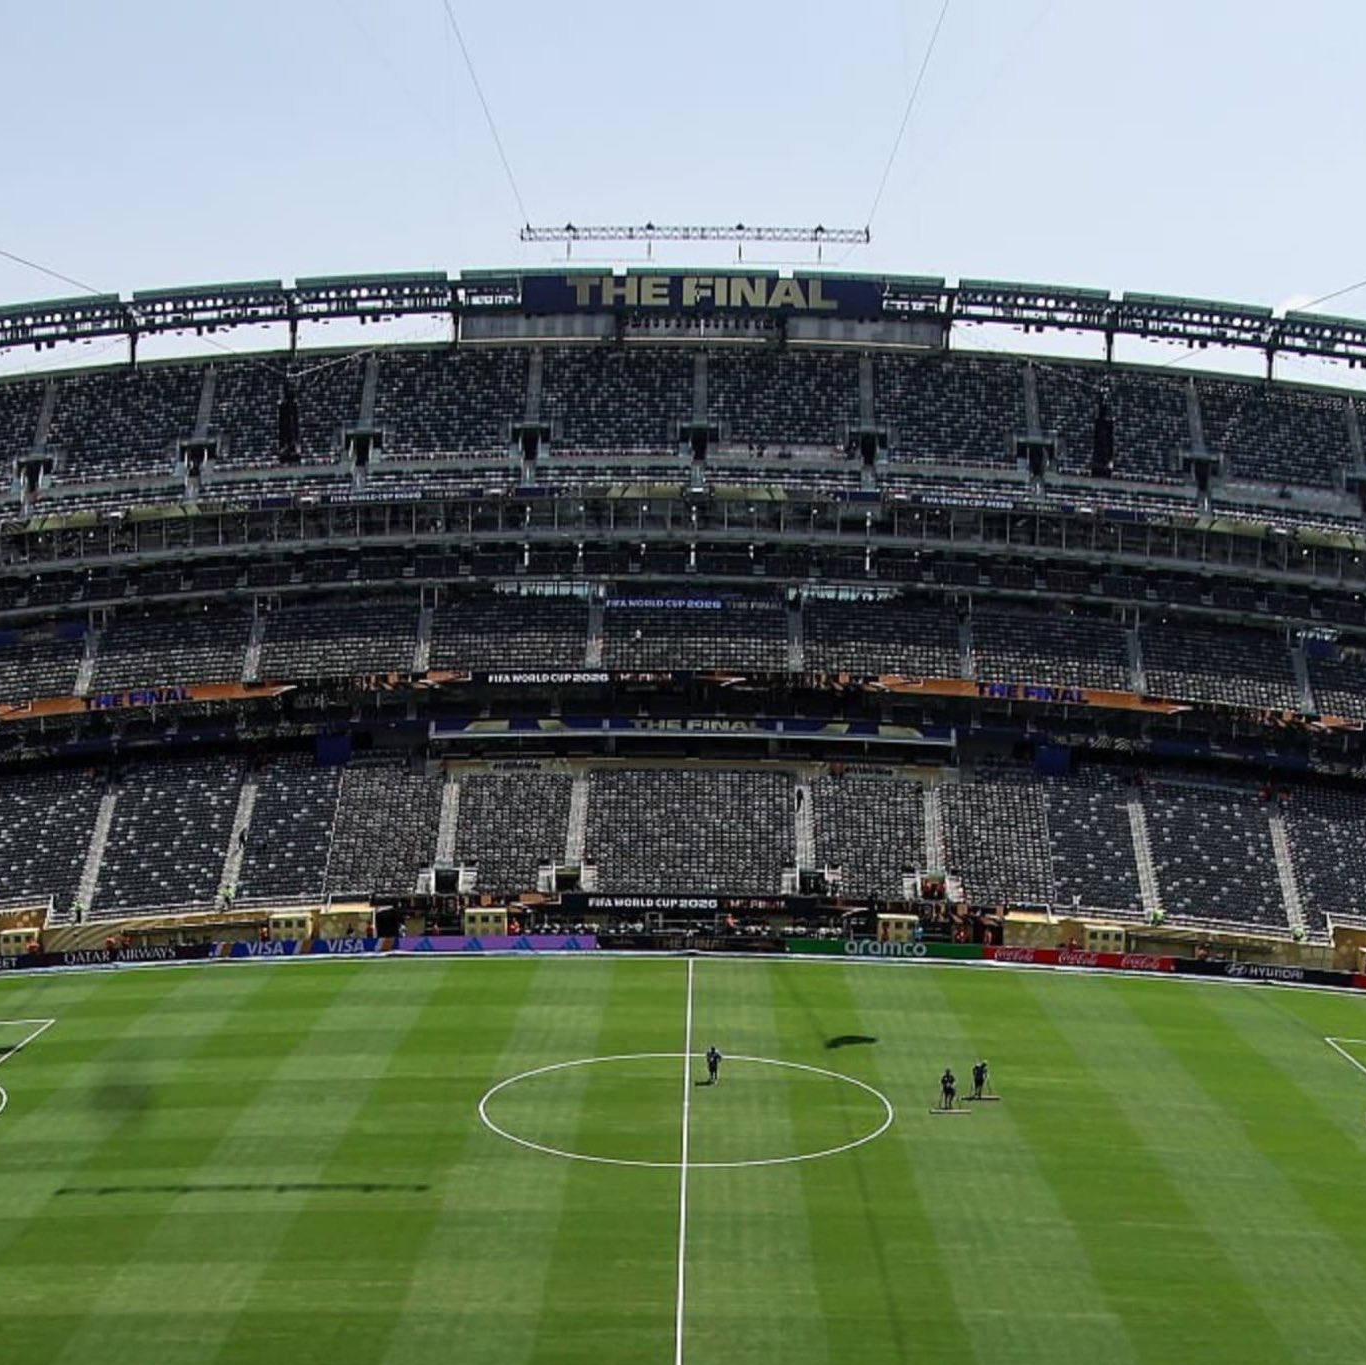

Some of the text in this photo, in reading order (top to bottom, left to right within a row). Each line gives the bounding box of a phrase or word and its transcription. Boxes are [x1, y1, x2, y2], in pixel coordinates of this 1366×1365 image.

[566, 276, 838, 310] THE FINAL
[488, 673, 511, 683] FIFA
[512, 673, 549, 683] WORLD
[551, 673, 572, 683] CUP
[573, 673, 609, 683] 2026
[630, 719, 765, 732] THE FINAL
[588, 897, 613, 908] FIFA
[614, 897, 654, 908] WORLD
[655, 897, 678, 908] CUP
[679, 899, 718, 909] 2026
[246, 941, 284, 955] VISA
[327, 939, 365, 953] VISA
[844, 940, 927, 957] aramco
[64, 946, 176, 965] QATAR AIRWAYS
[1249, 964, 1304, 980] HYUNDAI
